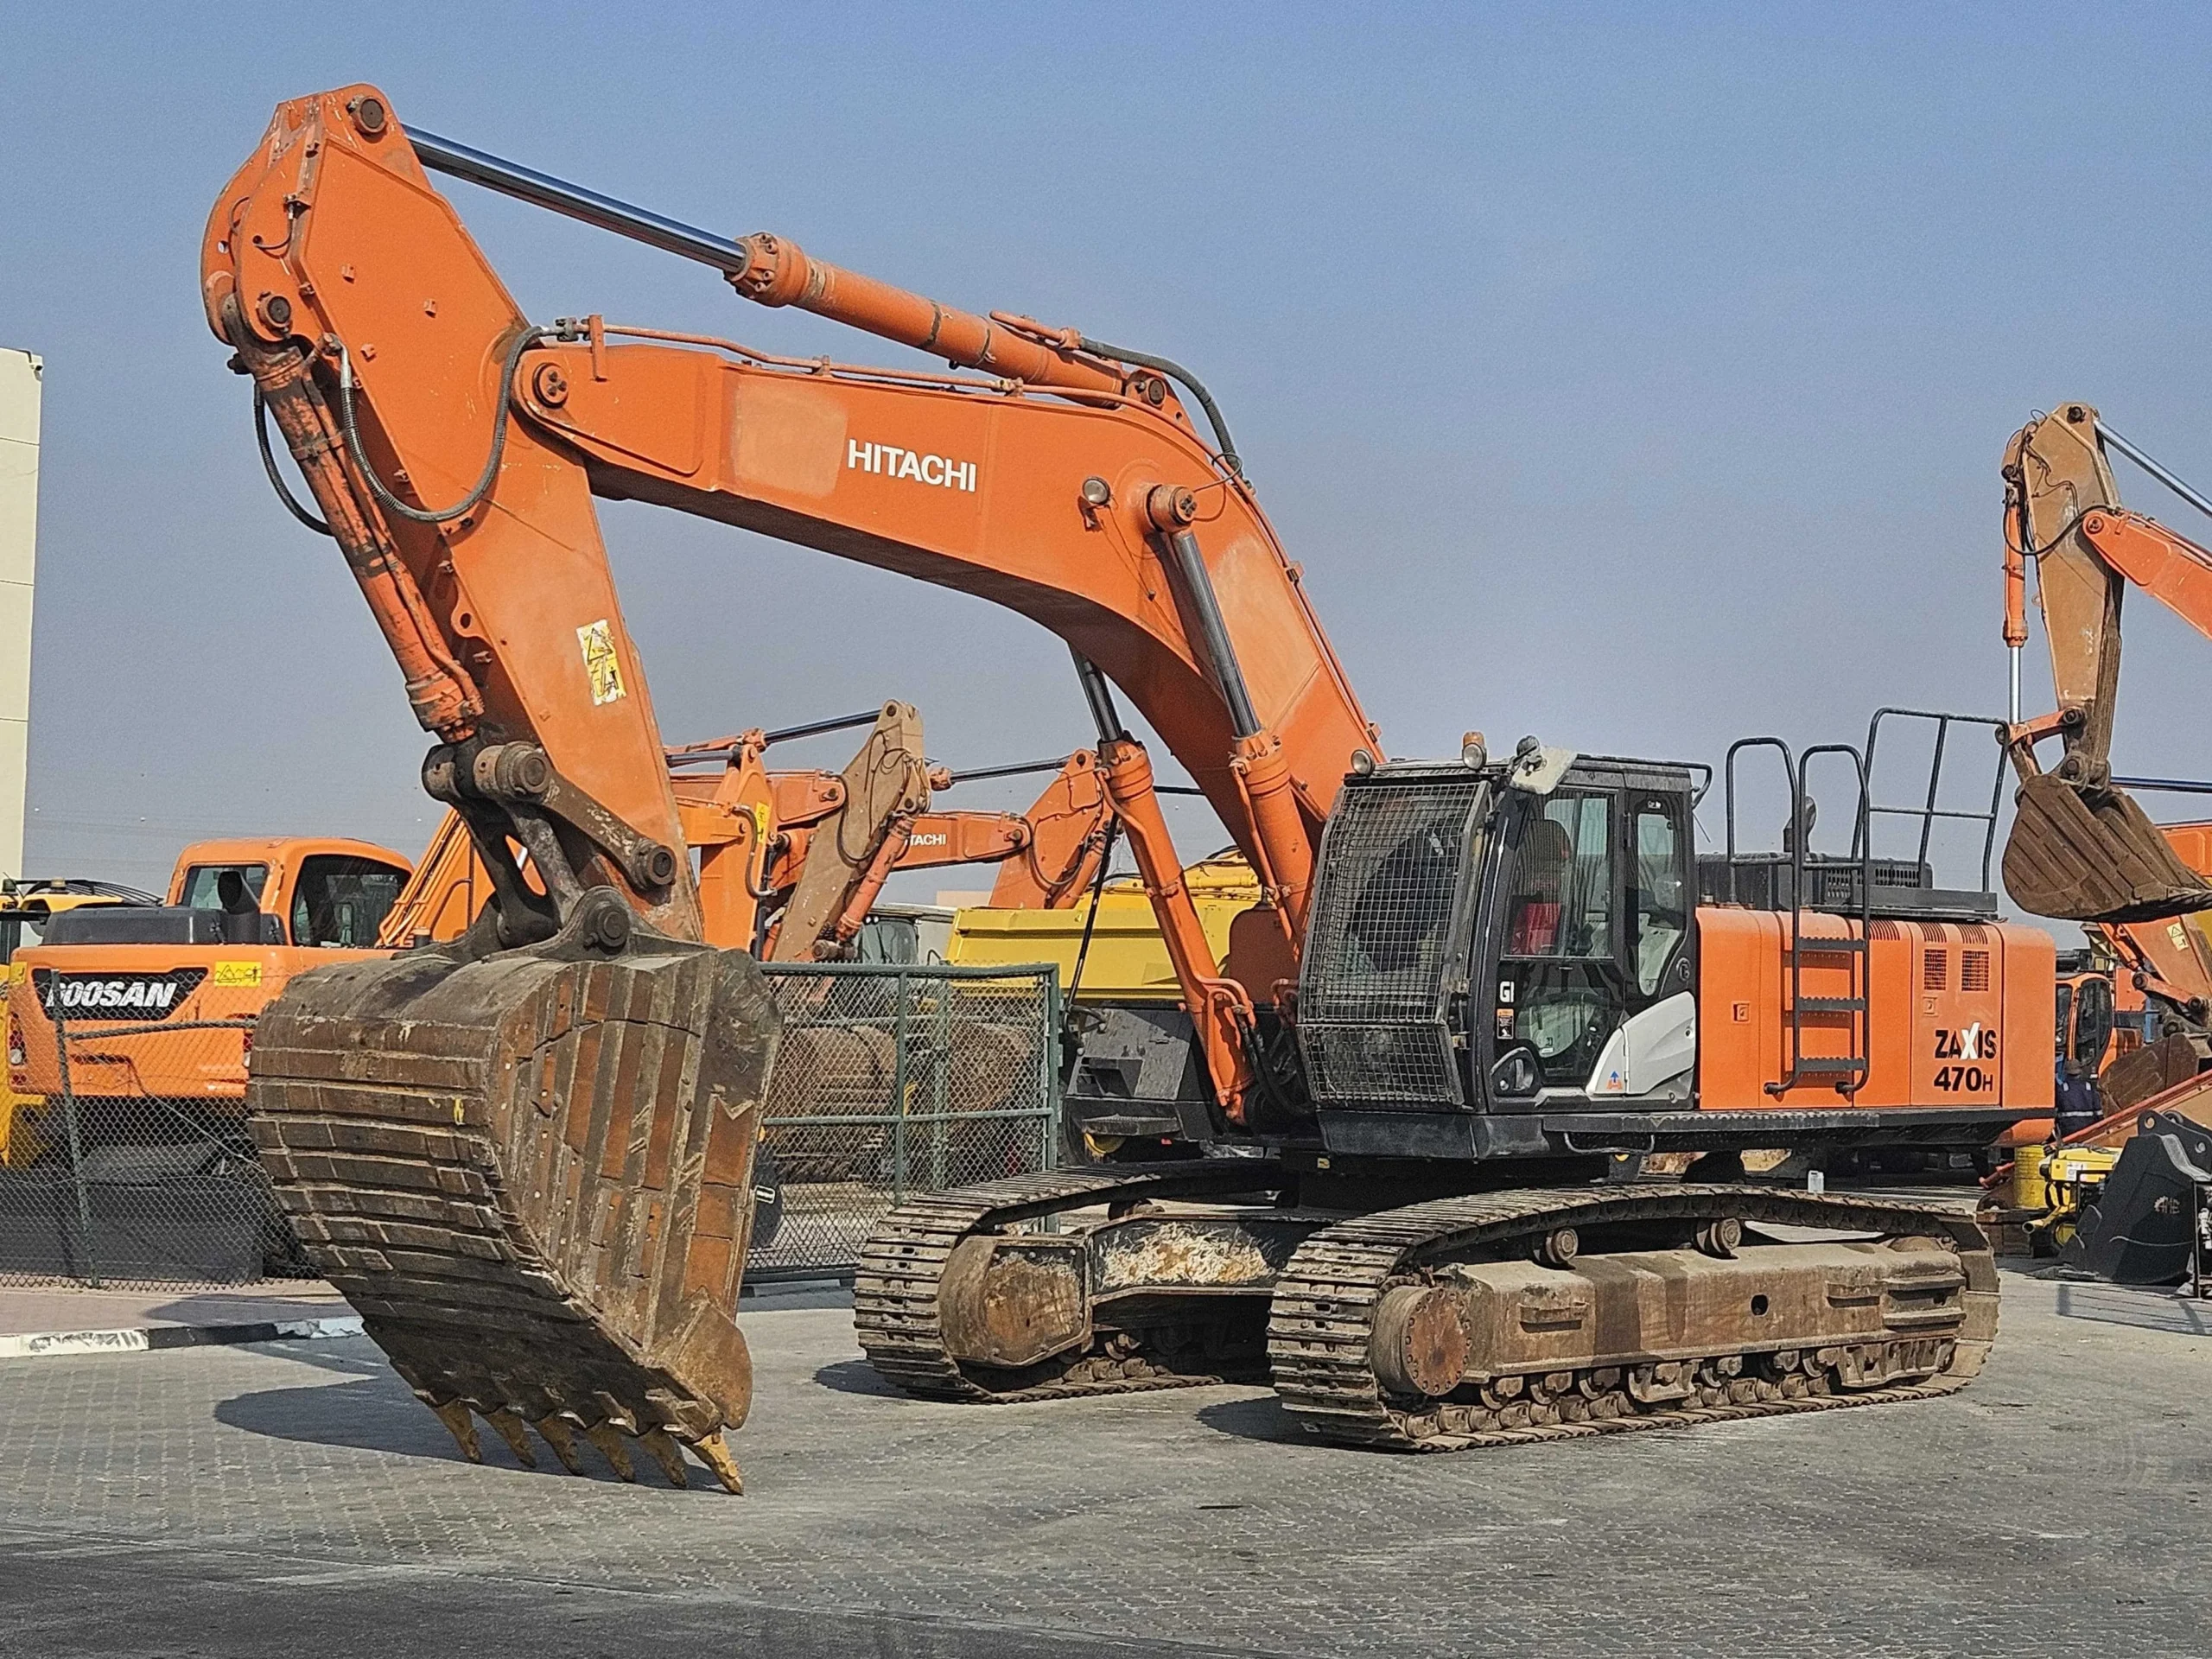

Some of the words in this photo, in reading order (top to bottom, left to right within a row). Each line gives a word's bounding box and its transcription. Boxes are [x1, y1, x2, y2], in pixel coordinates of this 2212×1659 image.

[848, 438, 976, 493] HITACHI
[910, 834, 946, 846] TACHI
[1935, 1021, 1997, 1060] ZAXIS
